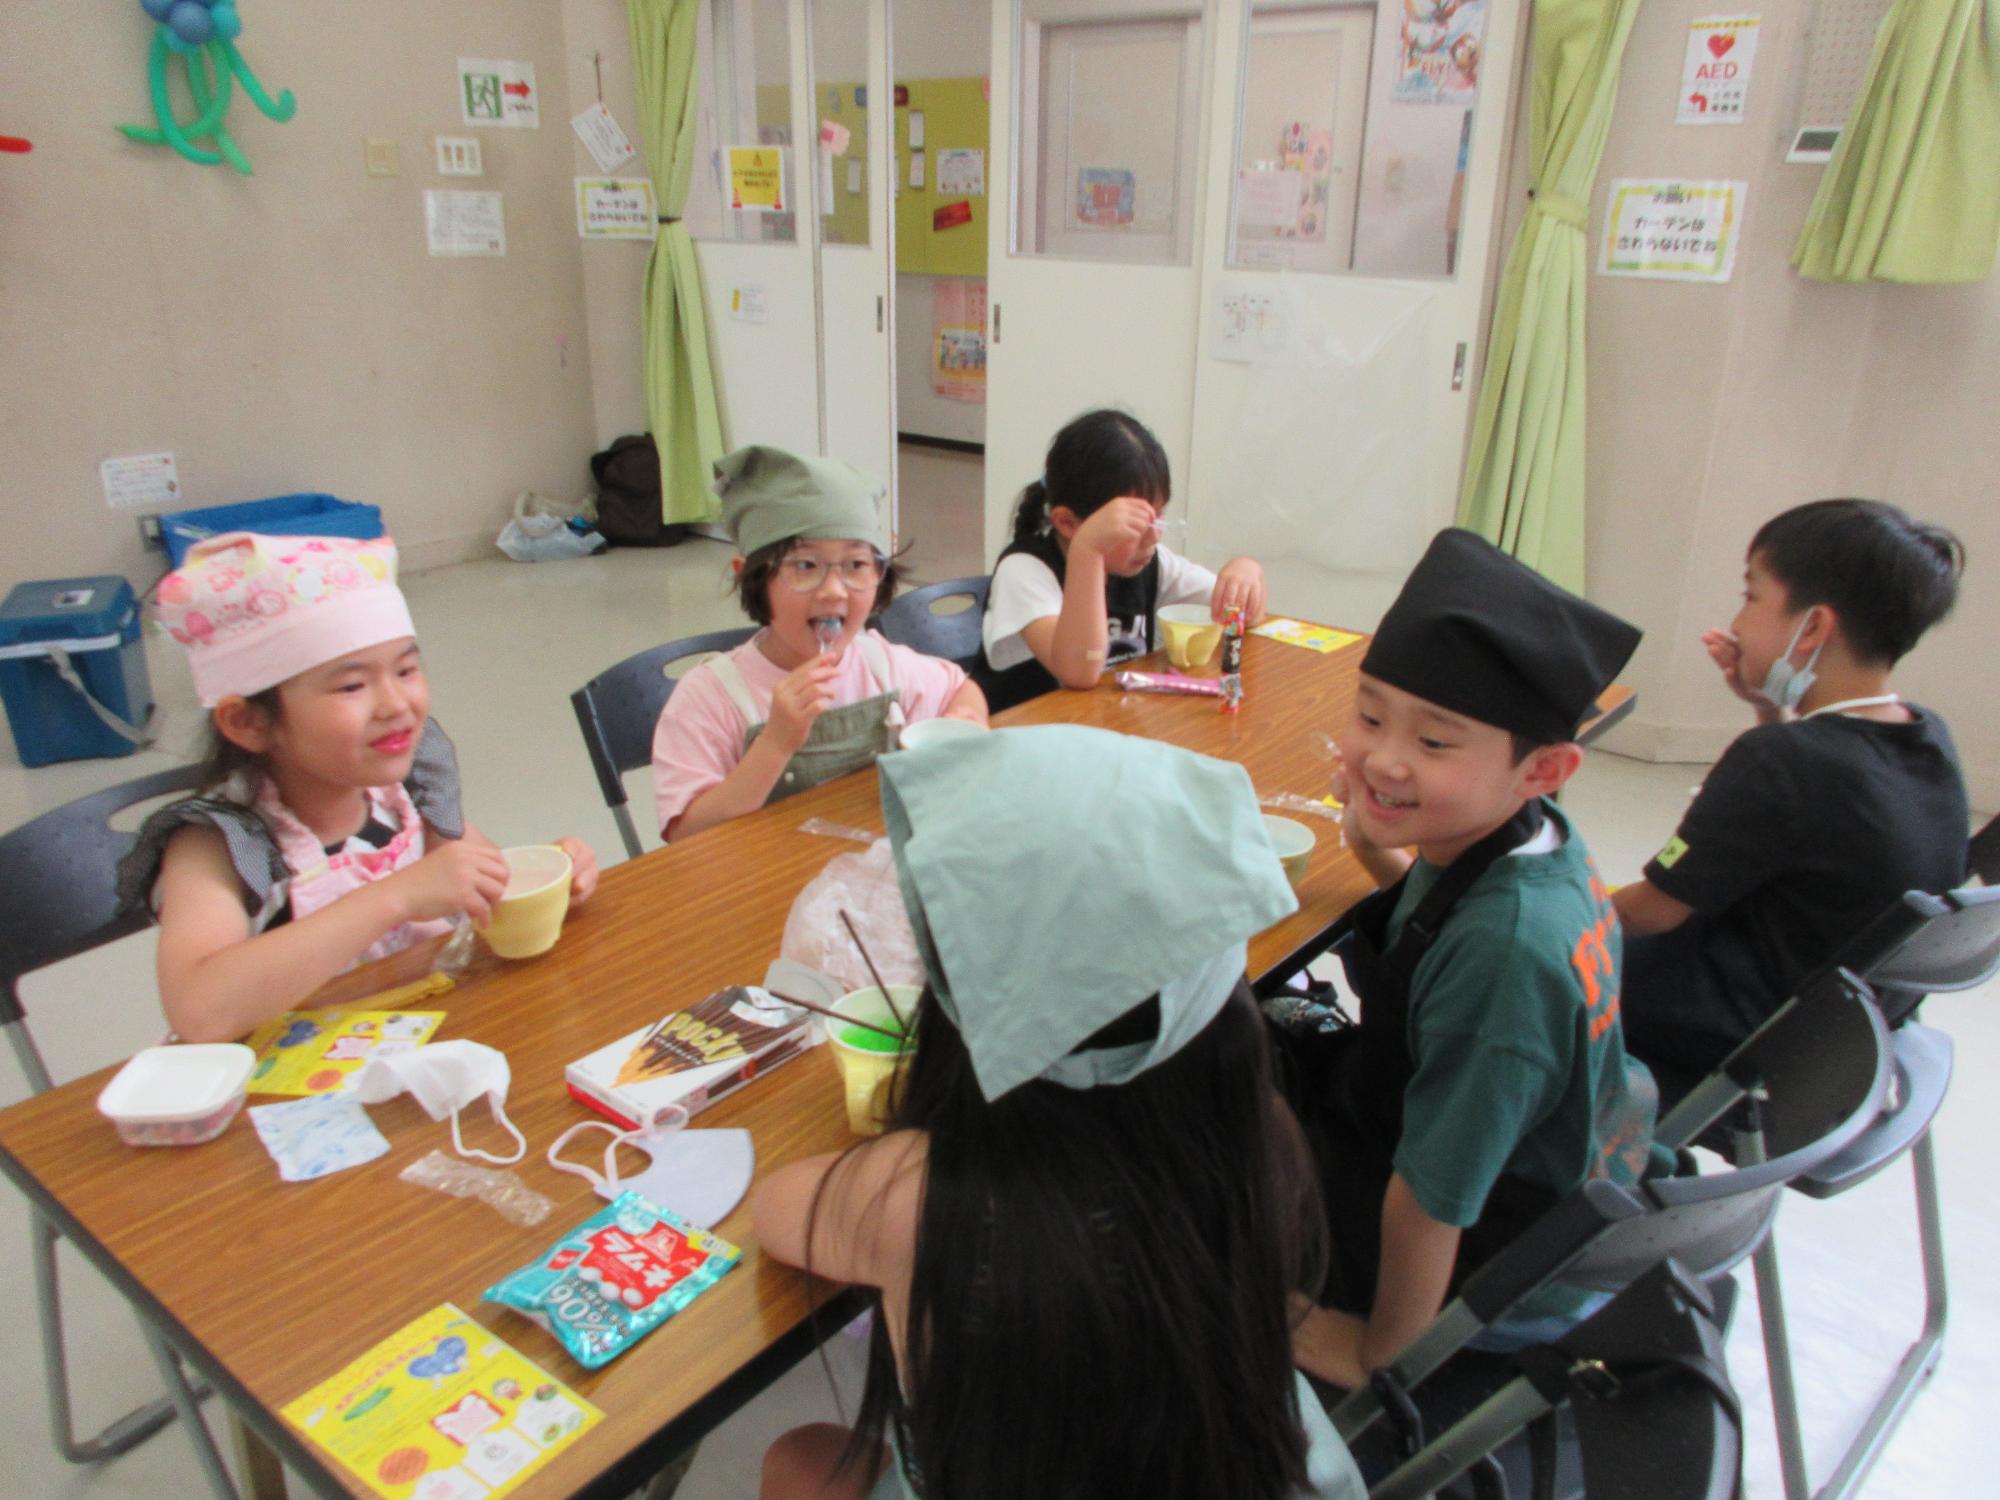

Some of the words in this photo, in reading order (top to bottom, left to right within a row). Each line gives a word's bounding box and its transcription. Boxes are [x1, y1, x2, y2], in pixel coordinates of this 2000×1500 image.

[1696, 62, 1738, 80] AED
[1634, 216, 1706, 233] カーテンは
[1616, 235, 1717, 253] さわらないでね
[602, 1231, 673, 1289] ラムネ
[549, 1283, 612, 1345] 90%
